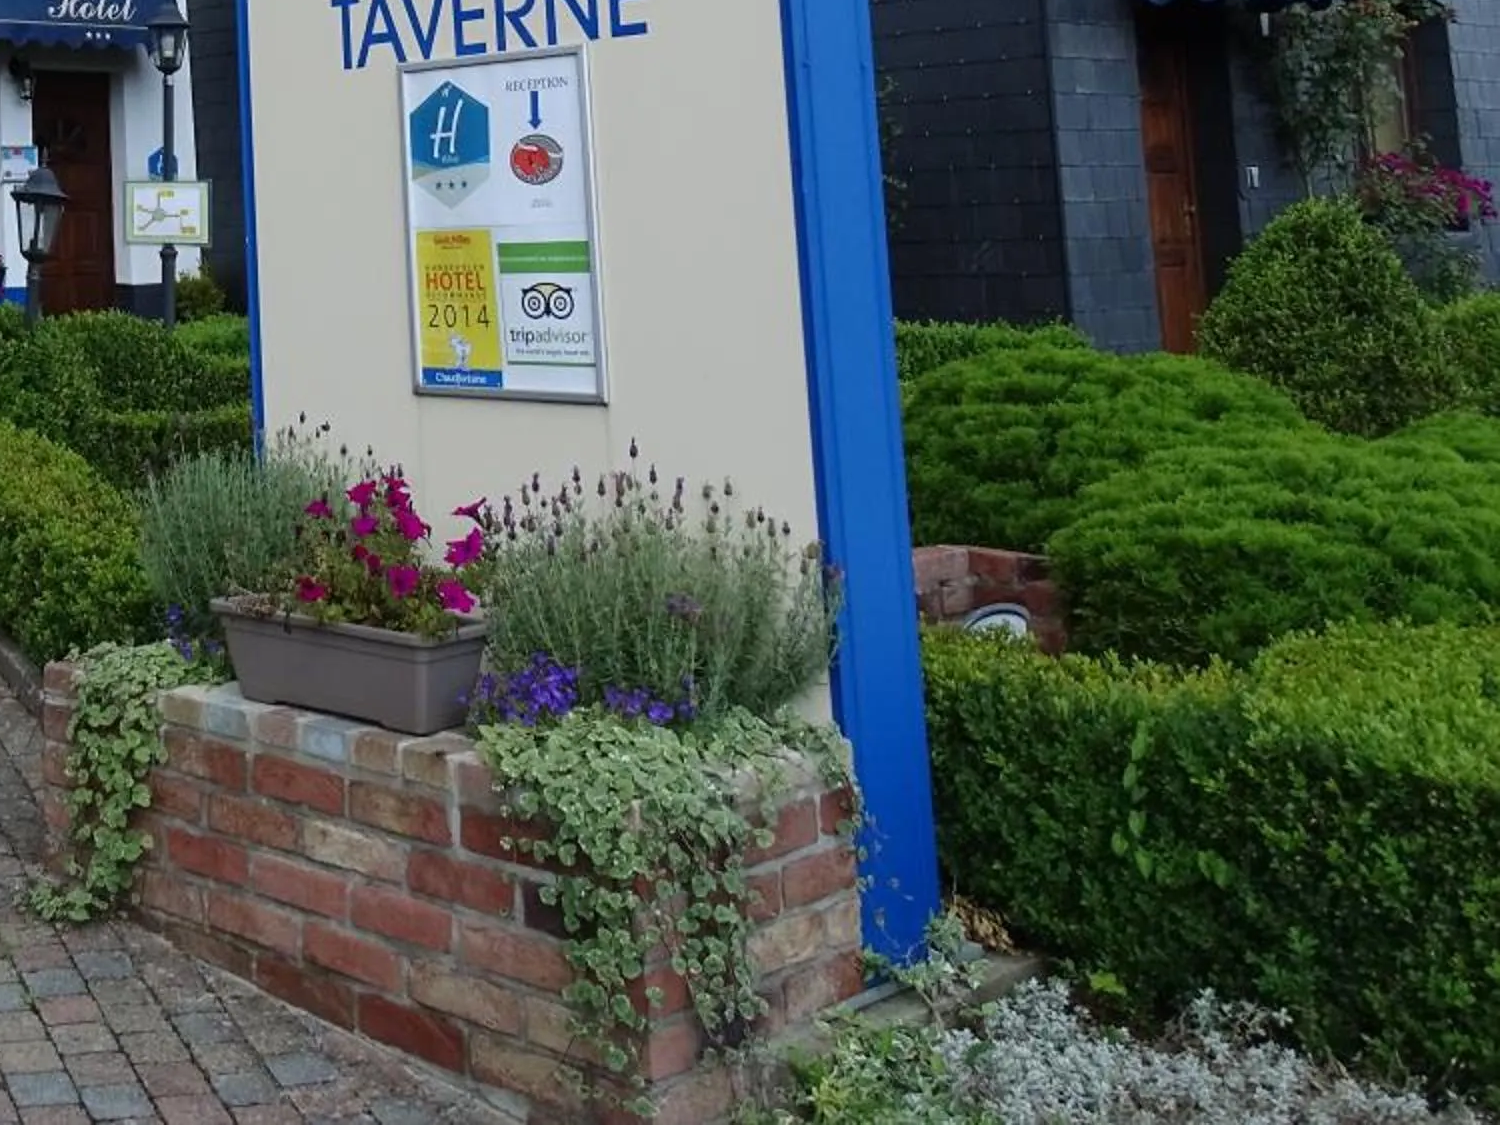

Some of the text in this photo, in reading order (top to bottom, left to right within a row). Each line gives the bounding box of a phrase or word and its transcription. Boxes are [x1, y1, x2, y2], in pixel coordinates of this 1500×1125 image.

[505, 76, 568, 92] RECEPTION
[429, 98, 464, 158] H
[425, 272, 485, 291] HOTEL
[427, 303, 491, 331] 2014
[509, 327, 587, 346] tripadvisor
